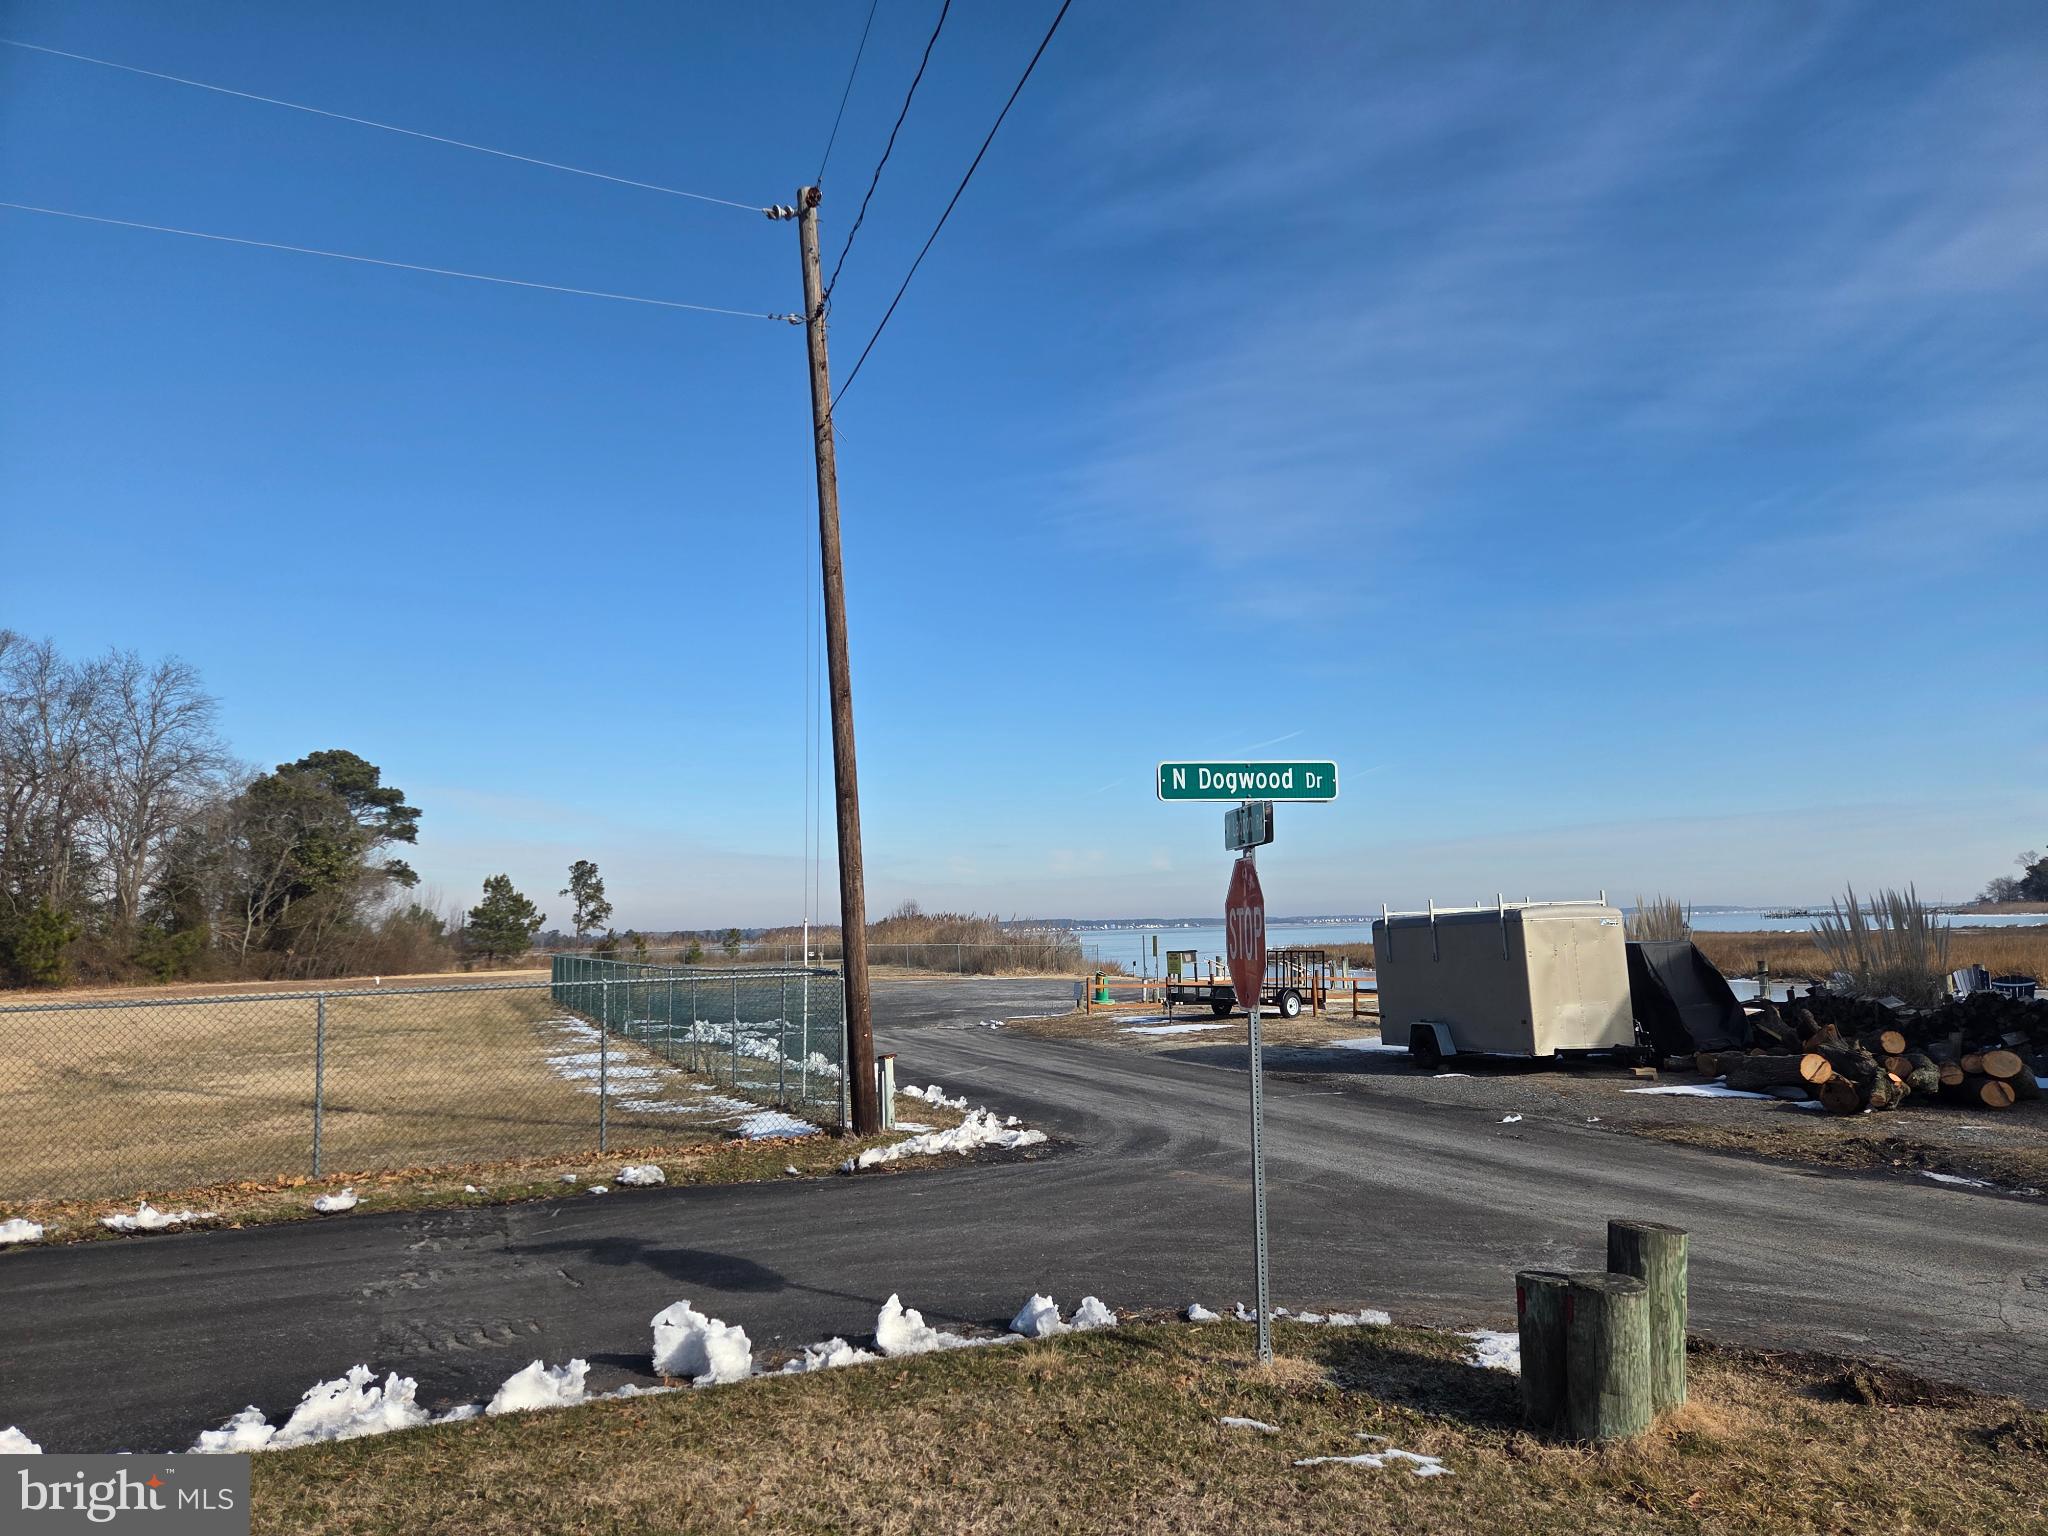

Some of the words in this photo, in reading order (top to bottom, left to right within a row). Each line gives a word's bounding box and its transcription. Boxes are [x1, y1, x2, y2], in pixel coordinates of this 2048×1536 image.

[1172, 768, 1186, 790] N
[1199, 767, 1293, 795] Dogwood
[1305, 772, 1322, 789] Dr
[1229, 907, 1262, 961] STOP
